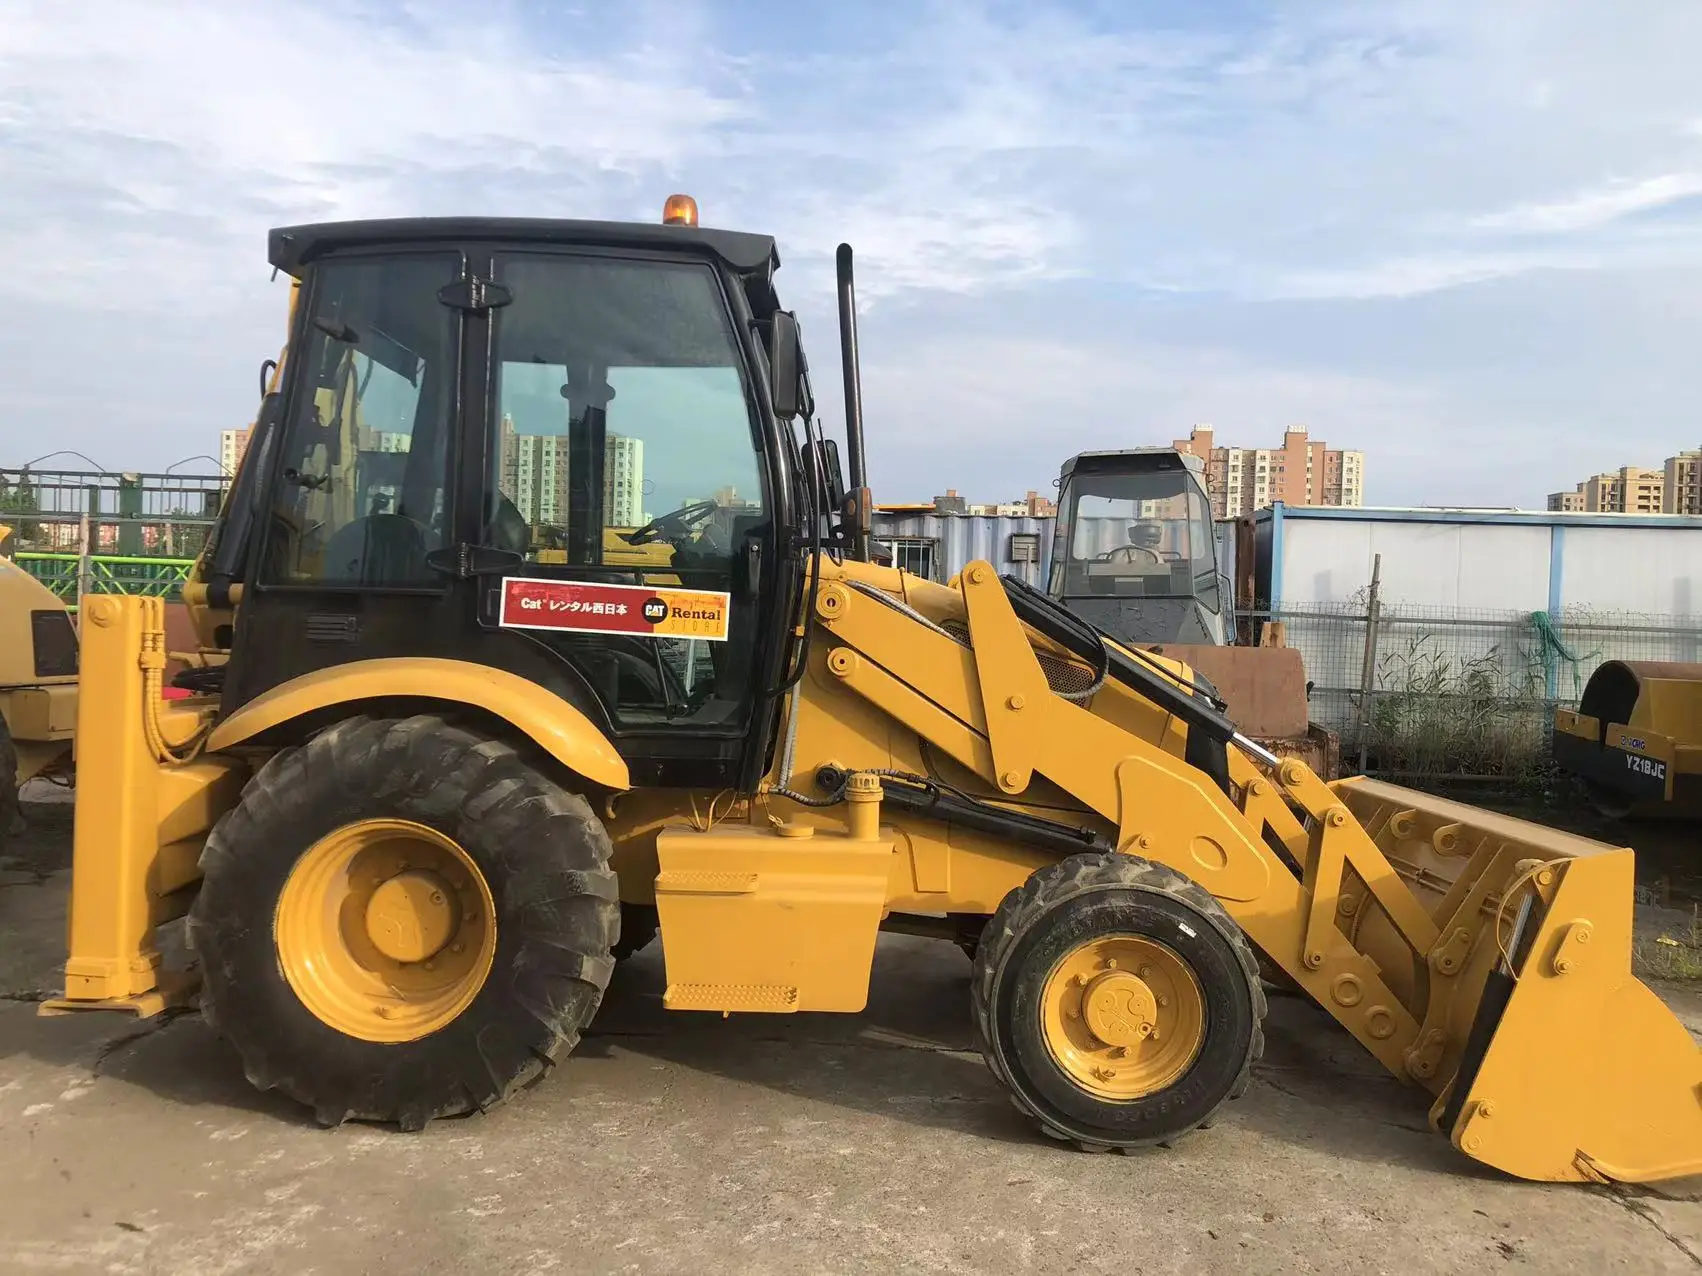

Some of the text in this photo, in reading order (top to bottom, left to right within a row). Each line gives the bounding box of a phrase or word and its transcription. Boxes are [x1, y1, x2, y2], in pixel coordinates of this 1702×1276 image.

[549, 601, 628, 616] レンタル西日本
[645, 604, 665, 617] CAT
[671, 607, 721, 621] Rental
[1626, 754, 1665, 779] YZ18JC
